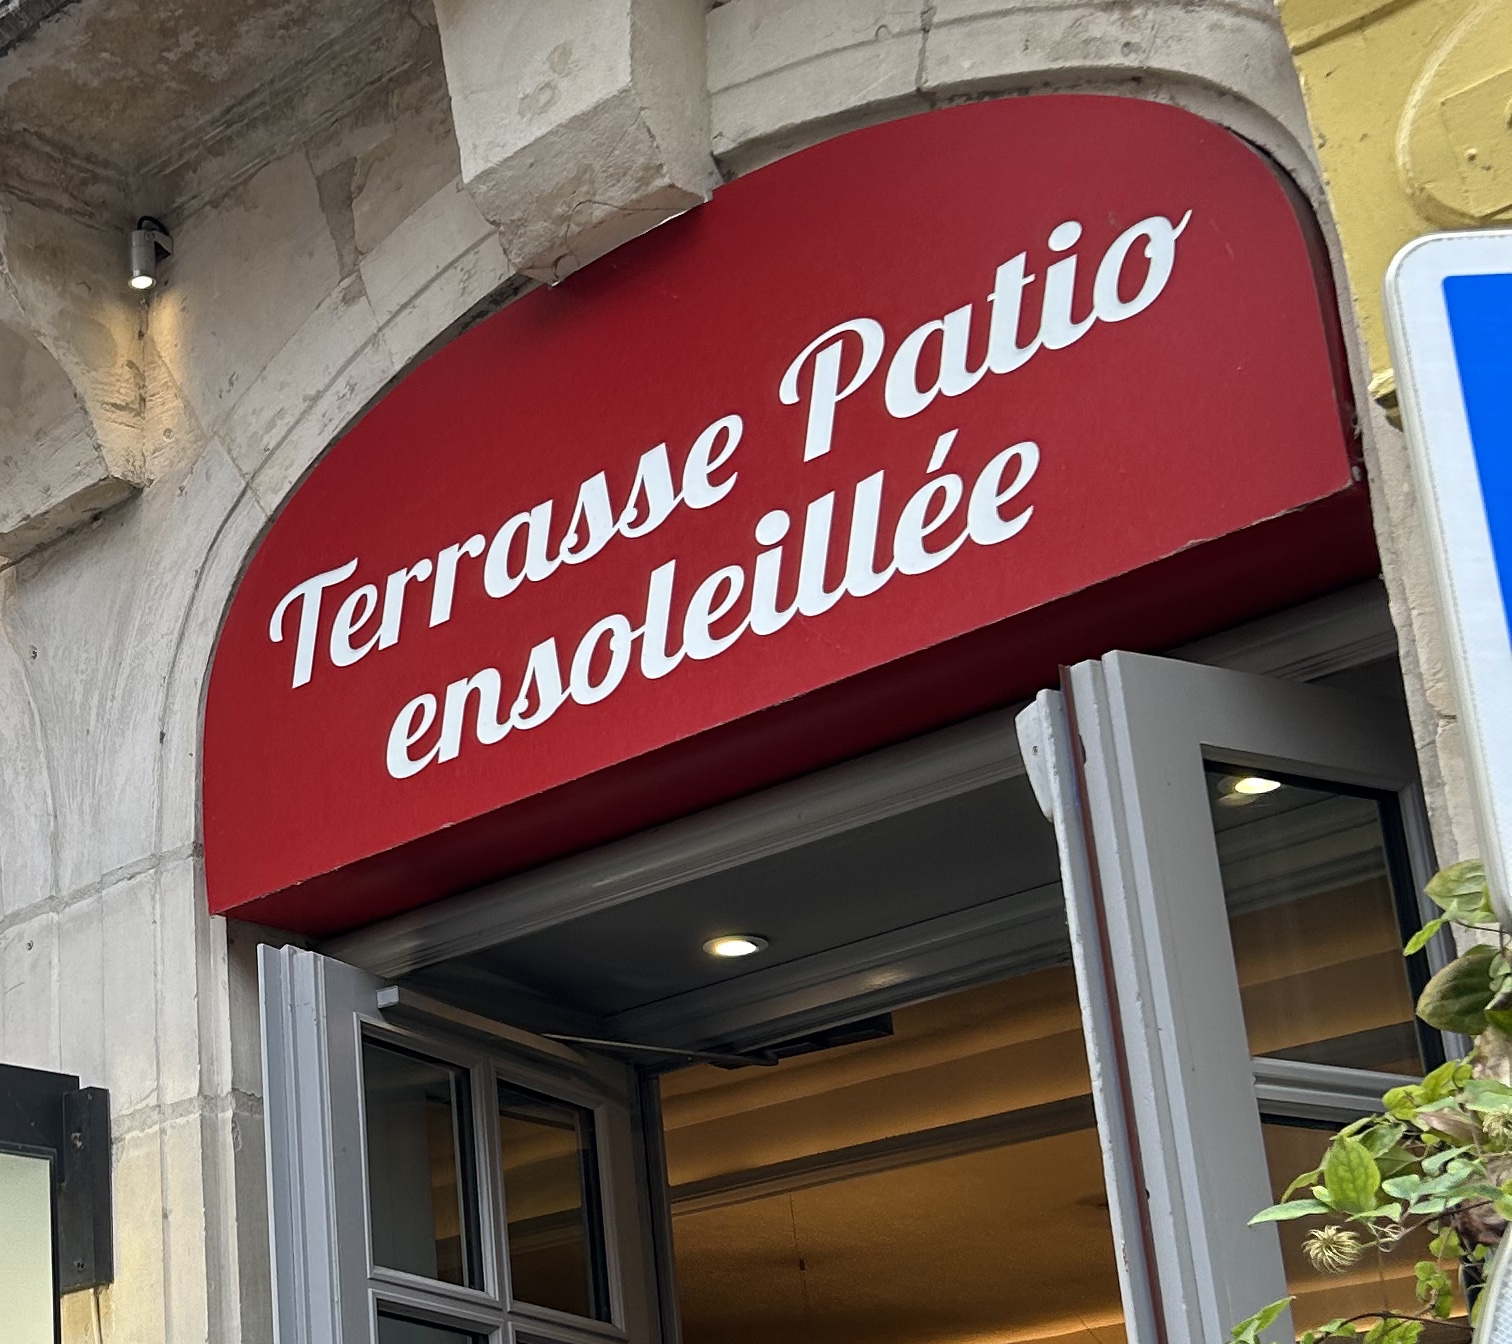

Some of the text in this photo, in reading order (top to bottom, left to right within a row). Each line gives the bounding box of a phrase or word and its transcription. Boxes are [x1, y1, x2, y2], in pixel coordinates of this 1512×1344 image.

[268, 208, 1193, 689] Terrasse Patio
[385, 427, 1041, 780] ensoleillée
